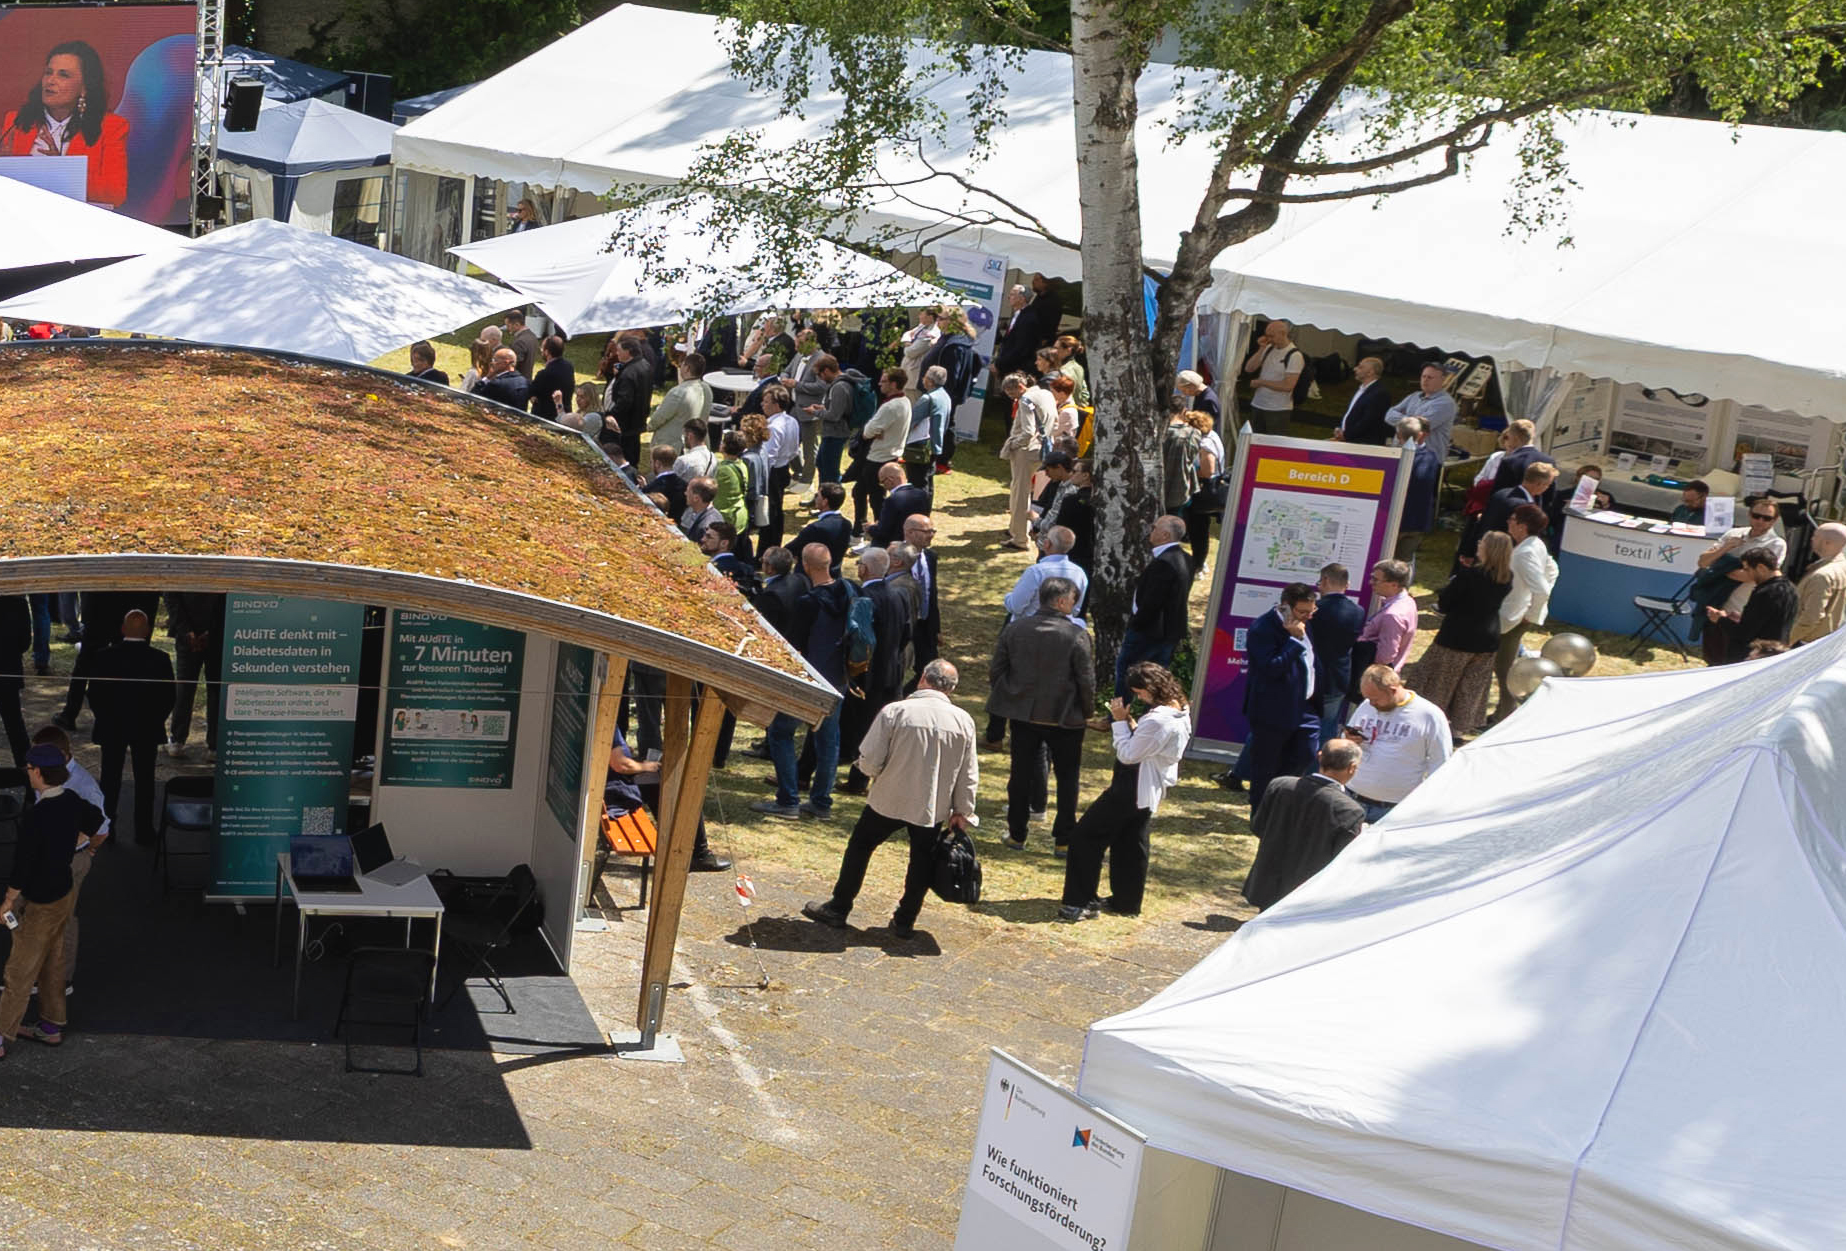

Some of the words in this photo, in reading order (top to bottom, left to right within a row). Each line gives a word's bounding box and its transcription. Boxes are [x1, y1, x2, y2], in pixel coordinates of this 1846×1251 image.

[1289, 468, 1336, 484] Bereich
[1340, 474, 1351, 484] D
[1615, 544, 1652, 560] textil
[233, 600, 279, 609] SINOVO
[234, 629, 276, 640] AUdiTE
[279, 629, 313, 640] denkt
[317, 629, 336, 640] mit
[399, 634, 415, 643] Mit
[418, 634, 452, 644] AUdiTE
[455, 635, 463, 644] in
[233, 646, 317, 657] Diabetesdaten
[321, 646, 332, 657] in
[414, 646, 425, 661] 7
[431, 646, 513, 663] Minuten
[232, 662, 289, 673] Sekunden
[293, 663, 350, 674] verstehen
[419, 664, 461, 673] besseren
[463, 665, 507, 676] Therapie!
[987, 1144, 1007, 1168] Wie
[1009, 1159, 1078, 1212] funktioniert
[982, 1164, 1107, 1251] Forschungsförderung?
